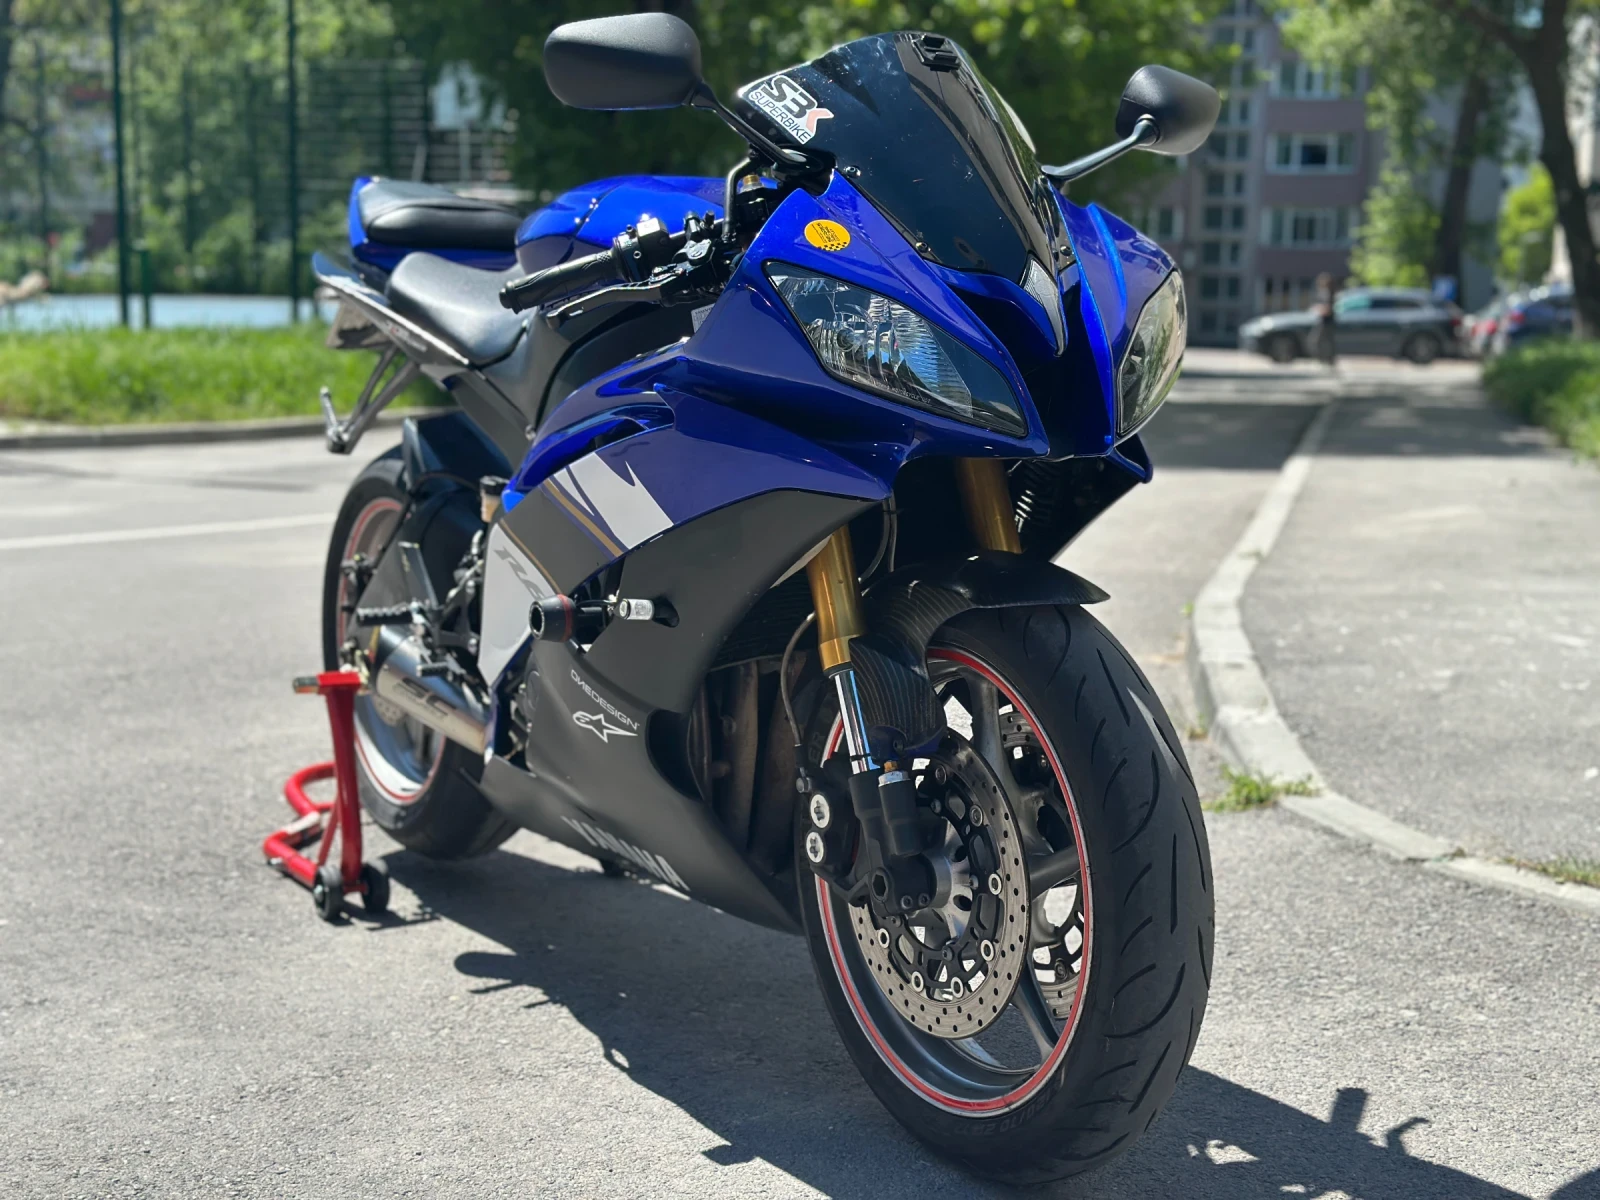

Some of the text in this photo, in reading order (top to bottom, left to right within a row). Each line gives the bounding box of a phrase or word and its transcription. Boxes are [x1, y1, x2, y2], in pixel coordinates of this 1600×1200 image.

[750, 91, 812, 143] SUPERBIKE
[760, 75, 834, 134] SBX
[493, 545, 546, 600] R6
[571, 669, 638, 731] ONEDESIGN
